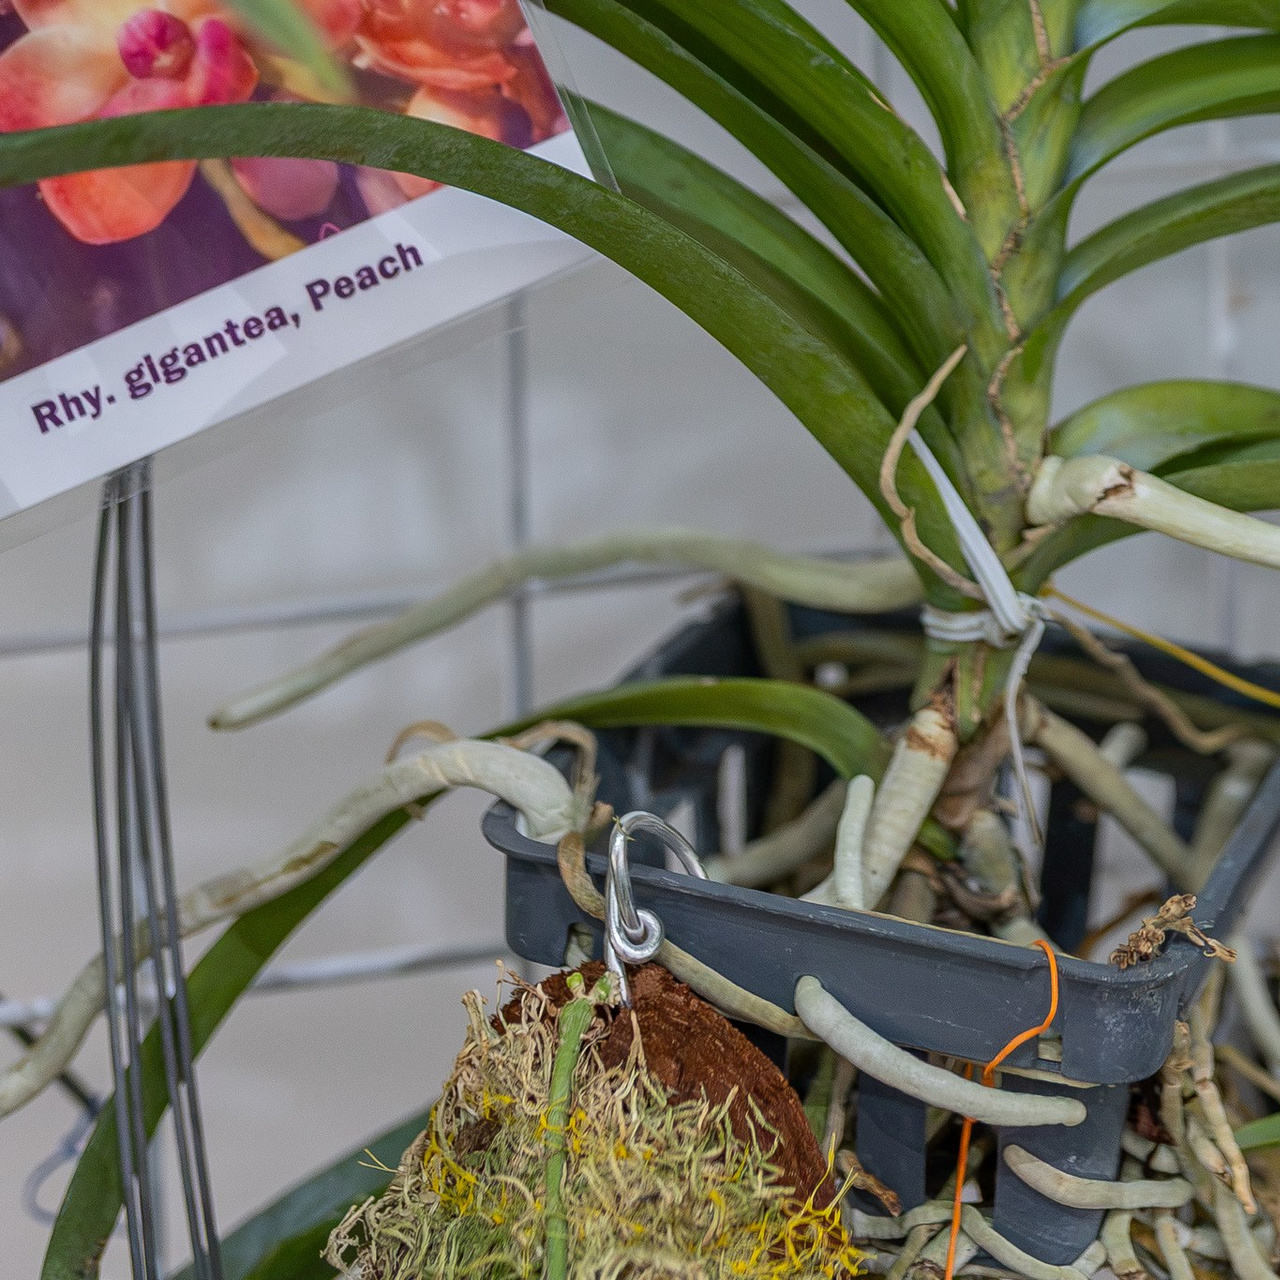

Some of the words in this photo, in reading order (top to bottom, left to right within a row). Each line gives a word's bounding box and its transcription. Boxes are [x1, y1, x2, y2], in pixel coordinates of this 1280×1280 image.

[30, 384, 116, 434] Rhy.
[124, 304, 301, 400] gigantea,
[305, 242, 425, 312] Peach
